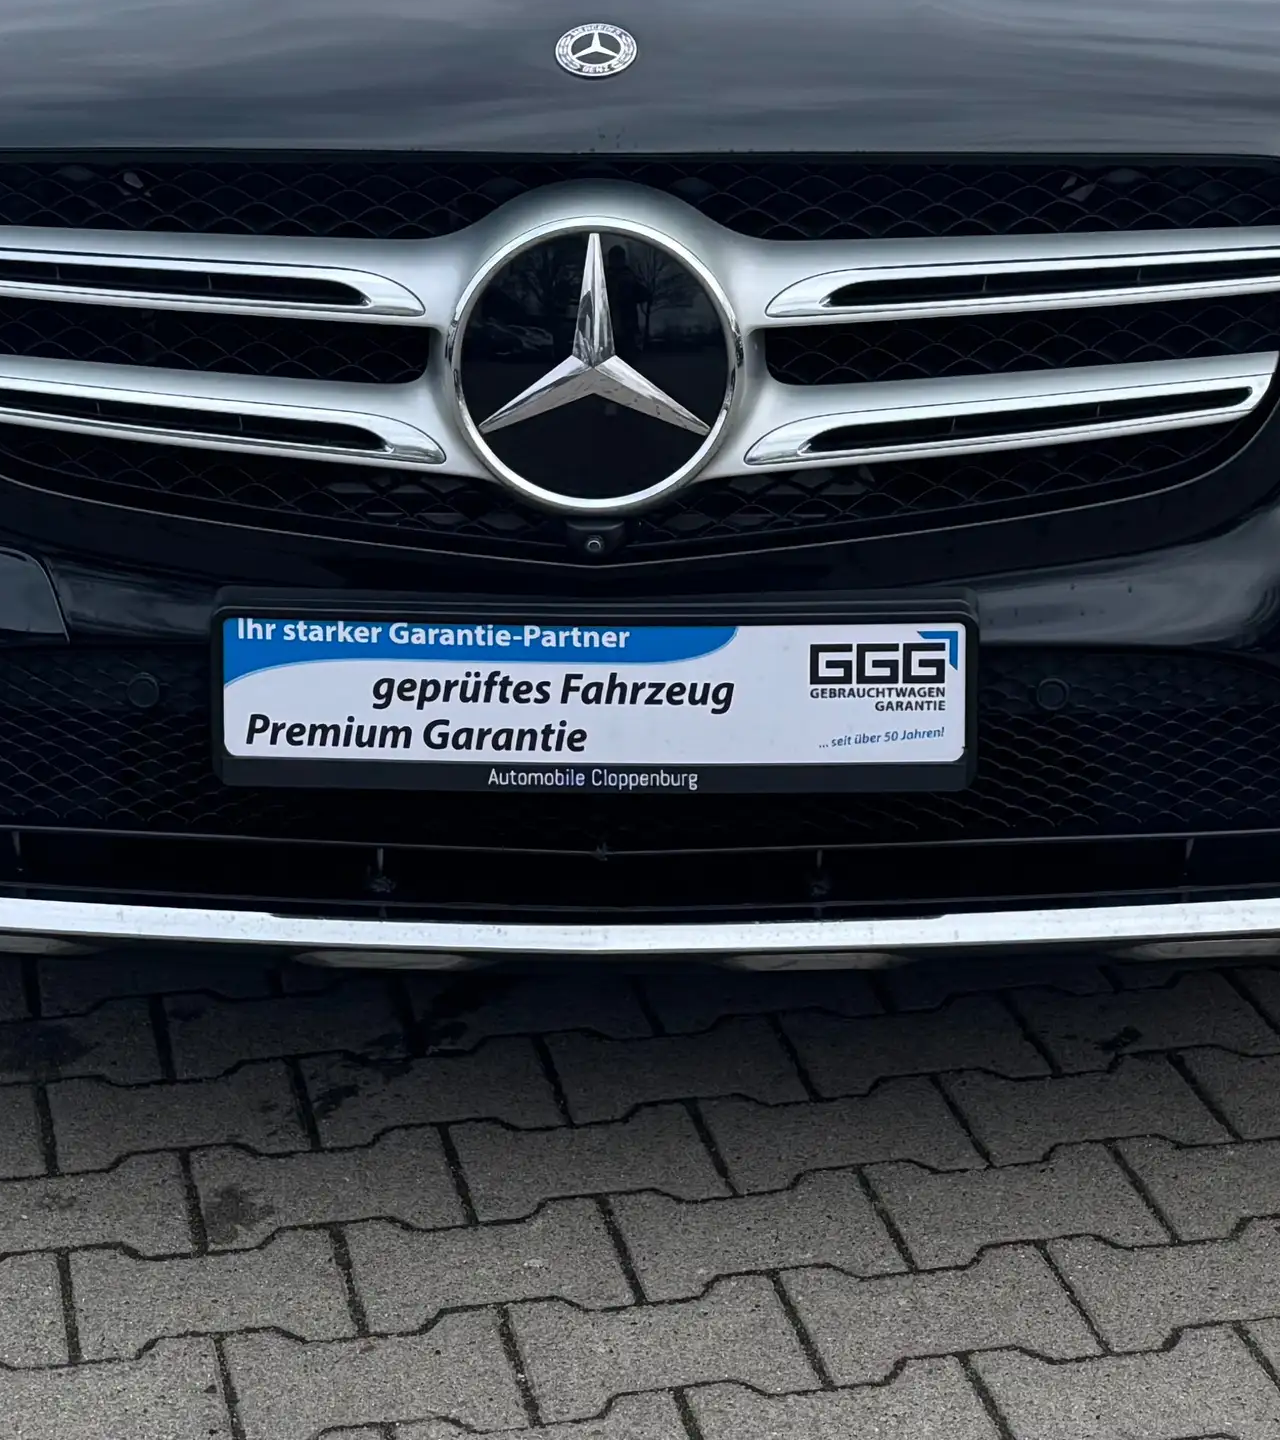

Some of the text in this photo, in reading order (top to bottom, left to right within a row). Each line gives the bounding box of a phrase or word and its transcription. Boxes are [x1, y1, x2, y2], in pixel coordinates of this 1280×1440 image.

[236, 618, 631, 648] Ihr starker Garantie-Partner
[810, 643, 945, 684] GGG
[372, 671, 735, 715] geprüftes Fahrzeug
[810, 686, 946, 699] GEBRAUCHTWAGEN
[875, 700, 946, 712] GARANTIE
[245, 713, 588, 753] Premium Garantie
[831, 735, 852, 747] seit
[854, 733, 882, 745] über
[884, 731, 898, 743] 50
[900, 726, 945, 741] Jahren!
[487, 768, 699, 791] Automobile Cloppenburg
